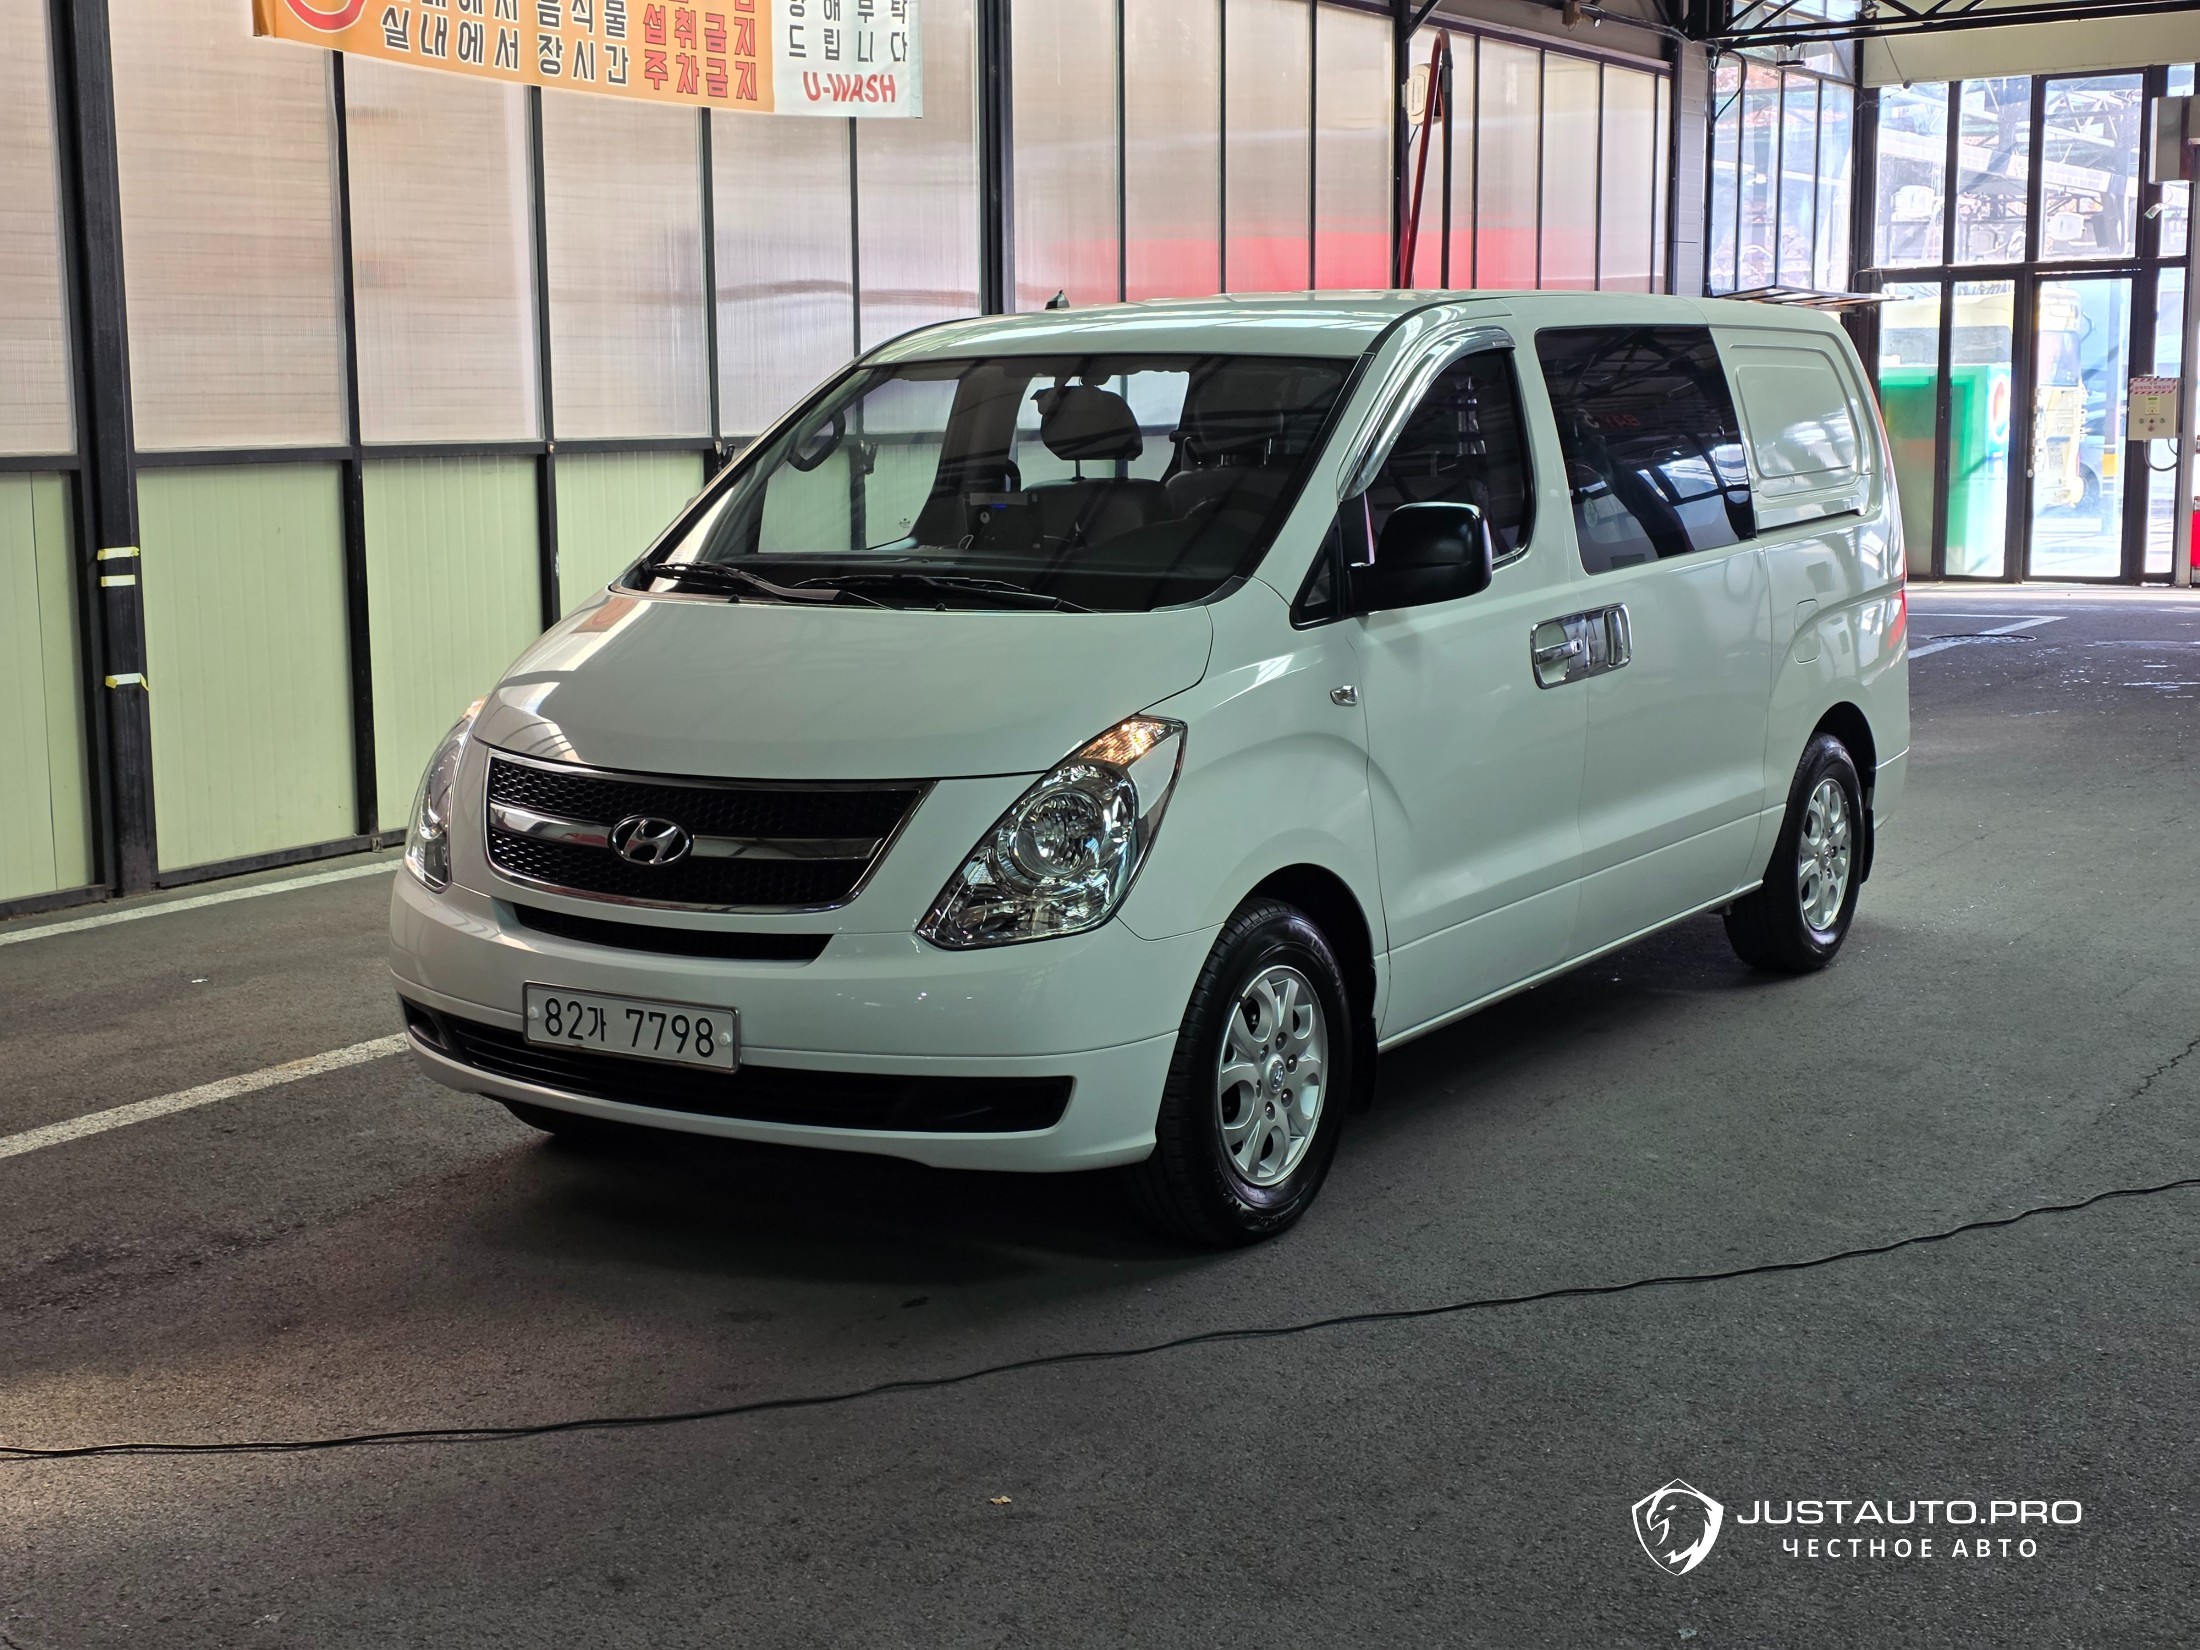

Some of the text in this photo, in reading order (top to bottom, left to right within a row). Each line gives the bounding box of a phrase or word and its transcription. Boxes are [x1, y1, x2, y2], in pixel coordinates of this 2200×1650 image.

[382, 6, 519, 70] 실내에서
[538, 35, 628, 85] 장시간
[644, 49, 758, 101] 주차금지
[643, 3, 756, 57] 섭취금지
[789, 24, 908, 62] 드립니다
[803, 71, 896, 103] U-WASH
[545, 997, 715, 1058] 82가 7798
